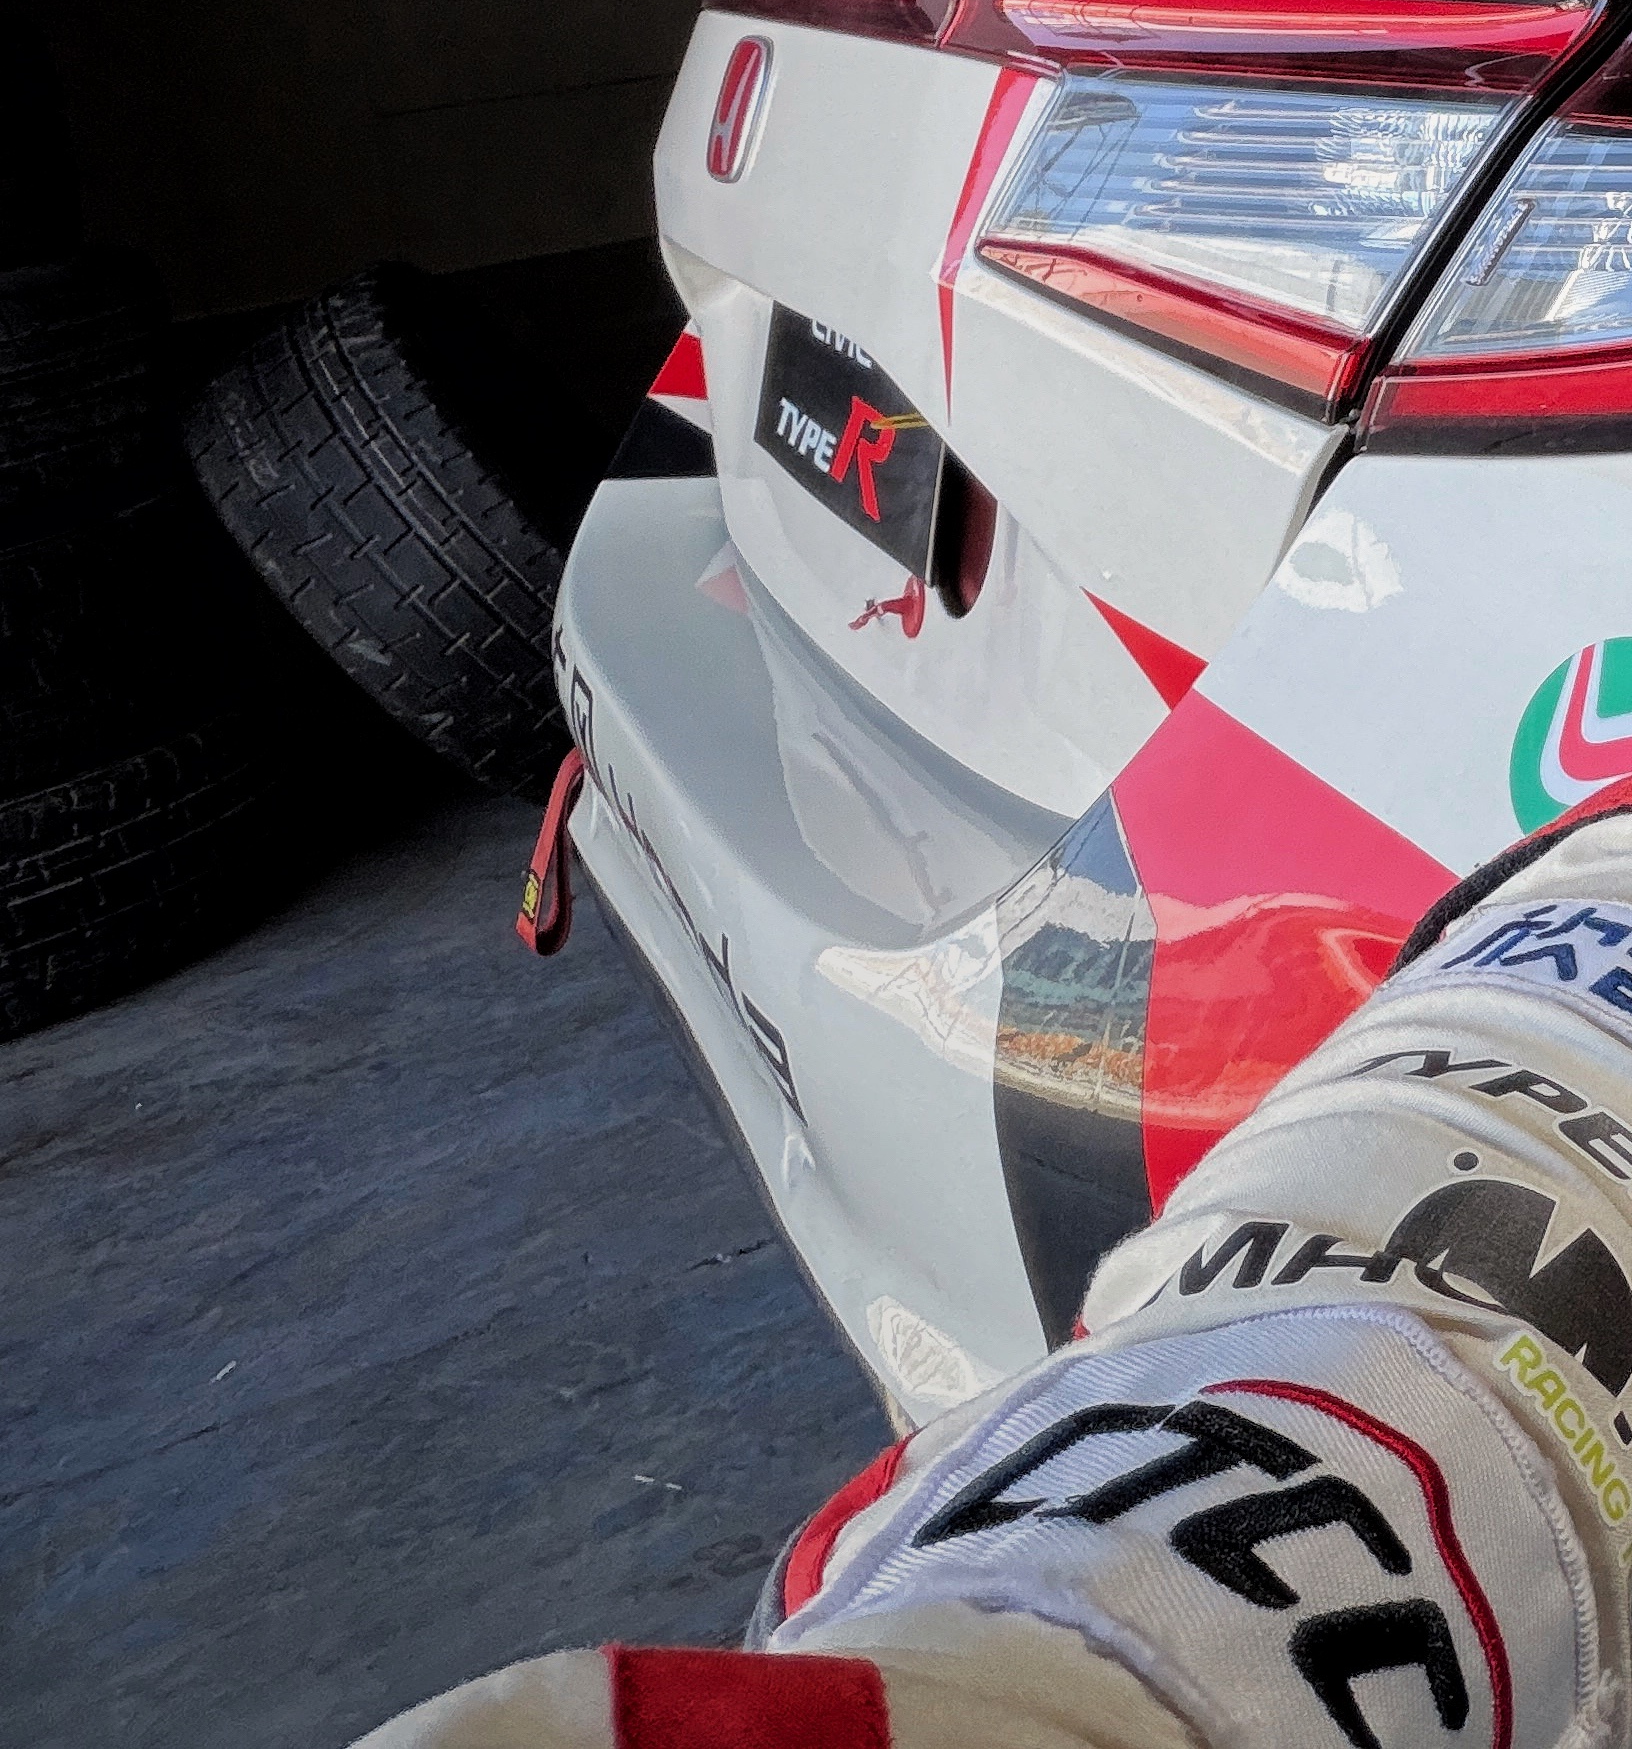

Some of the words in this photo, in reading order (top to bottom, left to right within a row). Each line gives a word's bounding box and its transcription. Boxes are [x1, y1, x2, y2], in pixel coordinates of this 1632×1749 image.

[779, 396, 838, 473] TYPE
[830, 395, 893, 524] R
[1499, 1331, 1632, 1524] RACING
